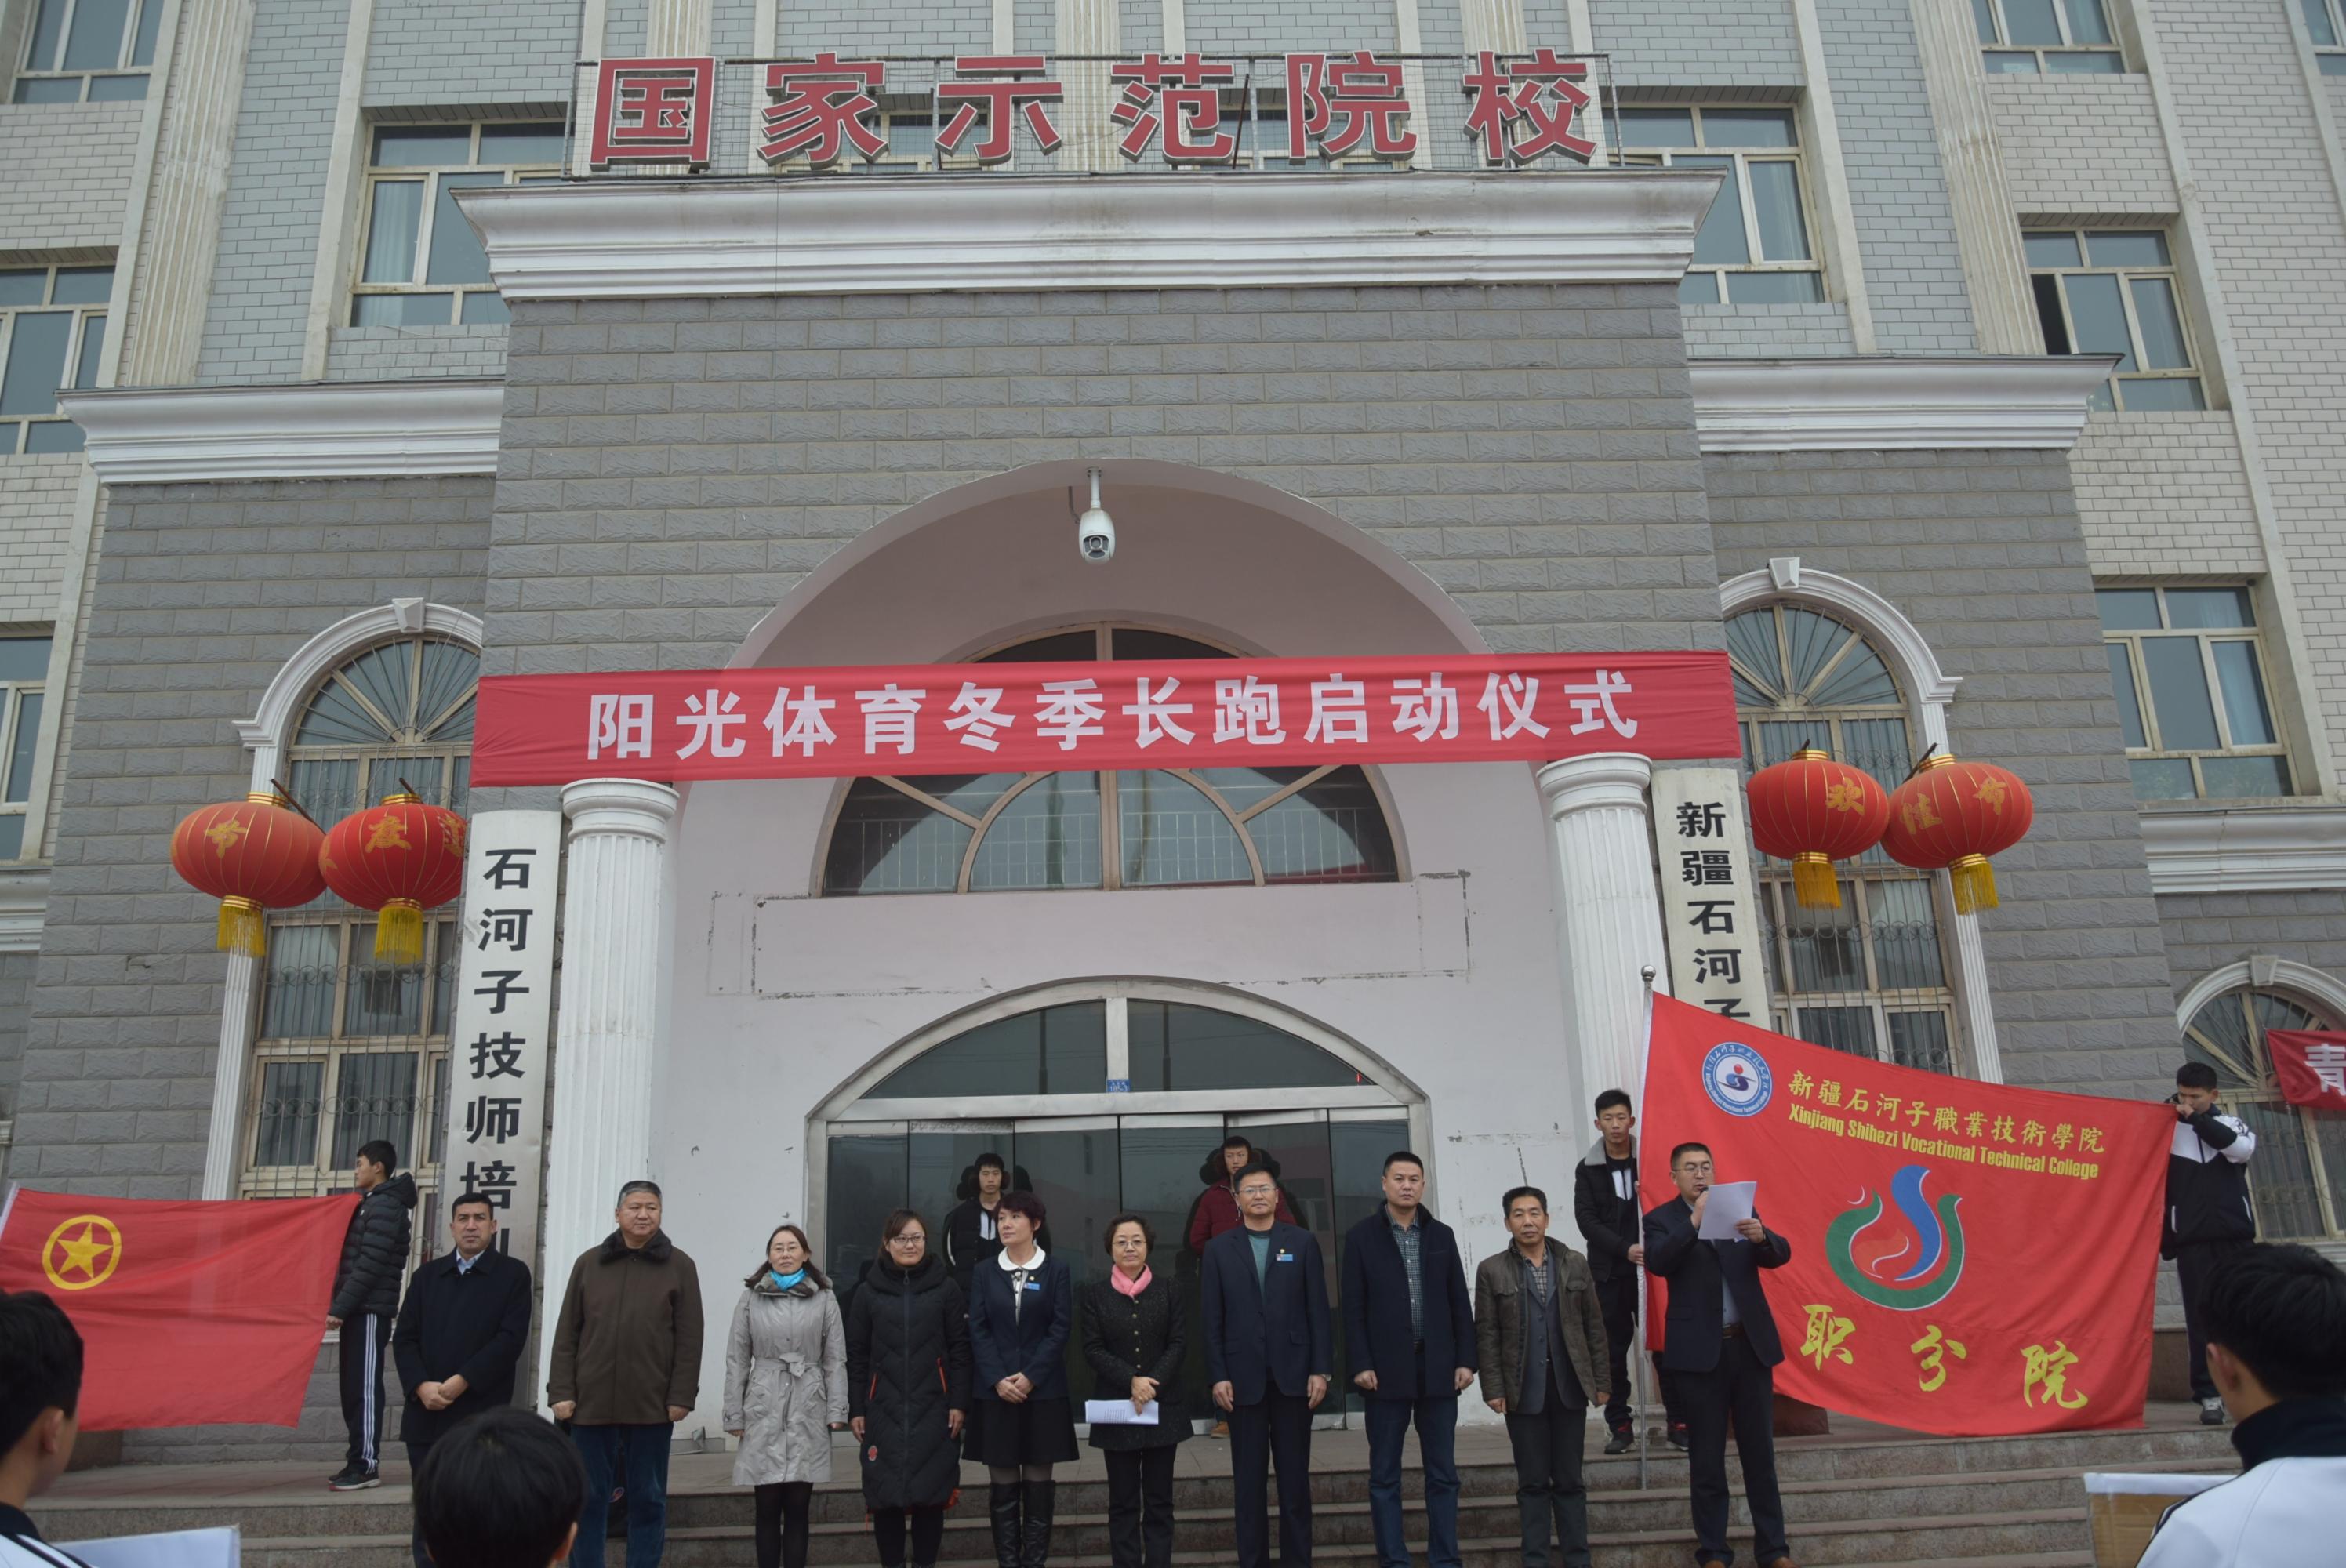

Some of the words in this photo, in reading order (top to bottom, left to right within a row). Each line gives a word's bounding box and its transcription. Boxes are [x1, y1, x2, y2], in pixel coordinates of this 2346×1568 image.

[590, 48, 1597, 164] 国家示范院校
[586, 669, 1639, 760] 阳光体育冬季长跑启动仪式
[460, 848, 537, 1254] 石河子技师培
[1788, 1070, 2104, 1153] 新疆石河子職業技術學院
[1789, 1104, 1844, 1137] Xinjiang
[1847, 1120, 1899, 1148] Shihezi
[1902, 1131, 1976, 1162] Vocational
[1980, 1146, 2046, 1172] Technical
[2049, 1156, 2099, 1180] College
[1800, 1304, 2089, 1410] 职分院
